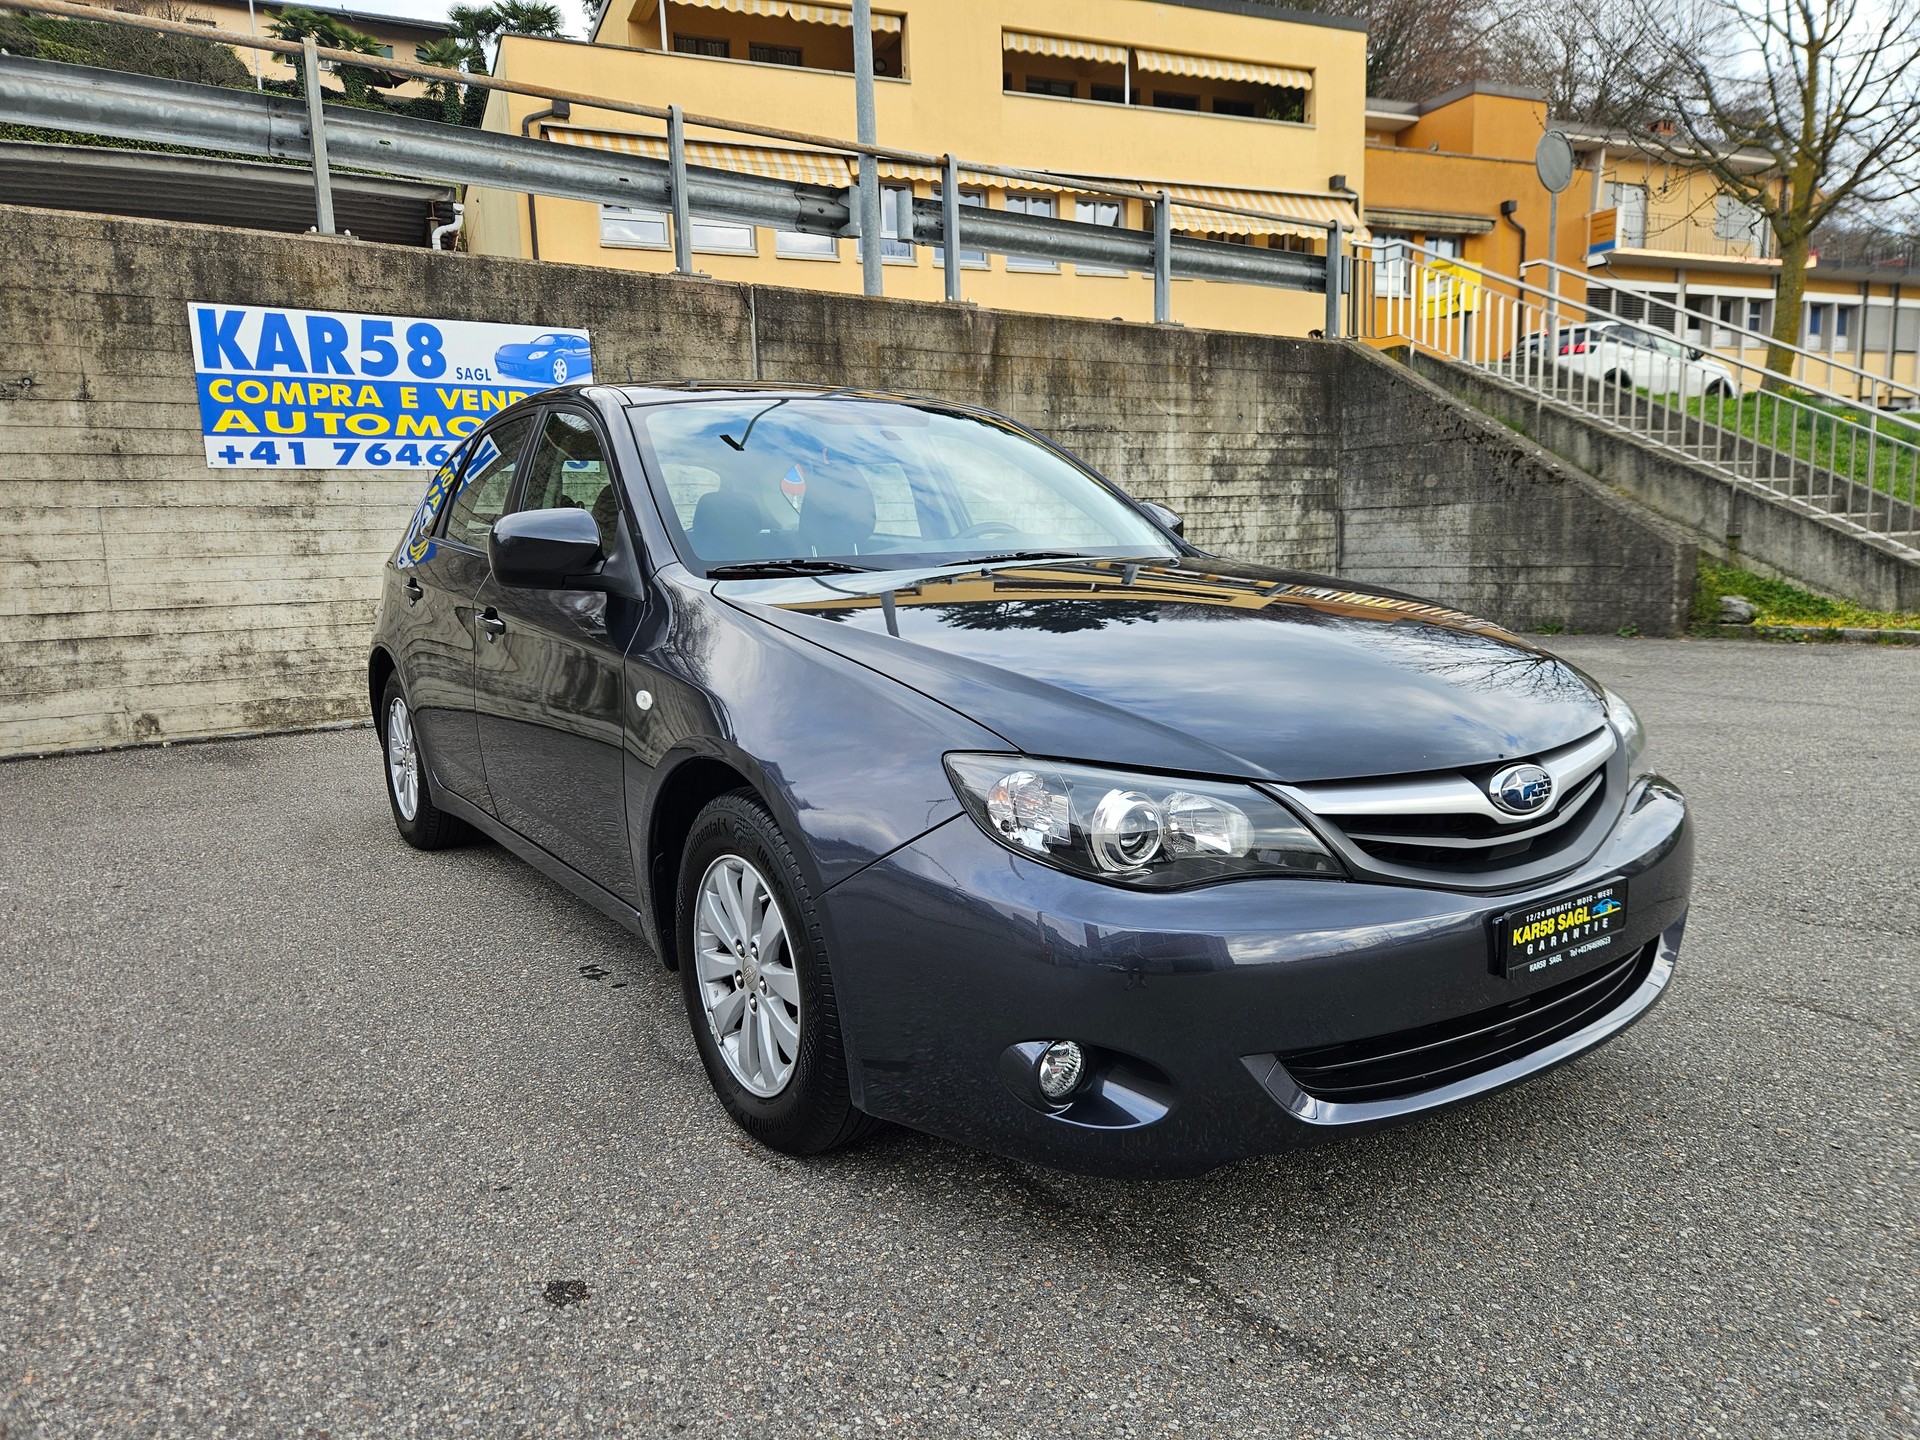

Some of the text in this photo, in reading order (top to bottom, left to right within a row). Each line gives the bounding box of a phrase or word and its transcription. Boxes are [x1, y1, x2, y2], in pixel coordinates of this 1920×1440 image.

[197, 308, 492, 382] KAR58 SAGL
[209, 379, 384, 408] COMPRA
[401, 387, 419, 409] E
[218, 441, 306, 466] +41
[1526, 910, 1545, 923] 12/24
[1546, 901, 1572, 916] MONATE
[1577, 895, 1593, 906] MOIS
[1512, 906, 1591, 946] KAR58 SAGL
[1526, 918, 1608, 955] GARANTIE
[1529, 960, 1546, 972] KAR58
[1549, 954, 1562, 965] SAGL
